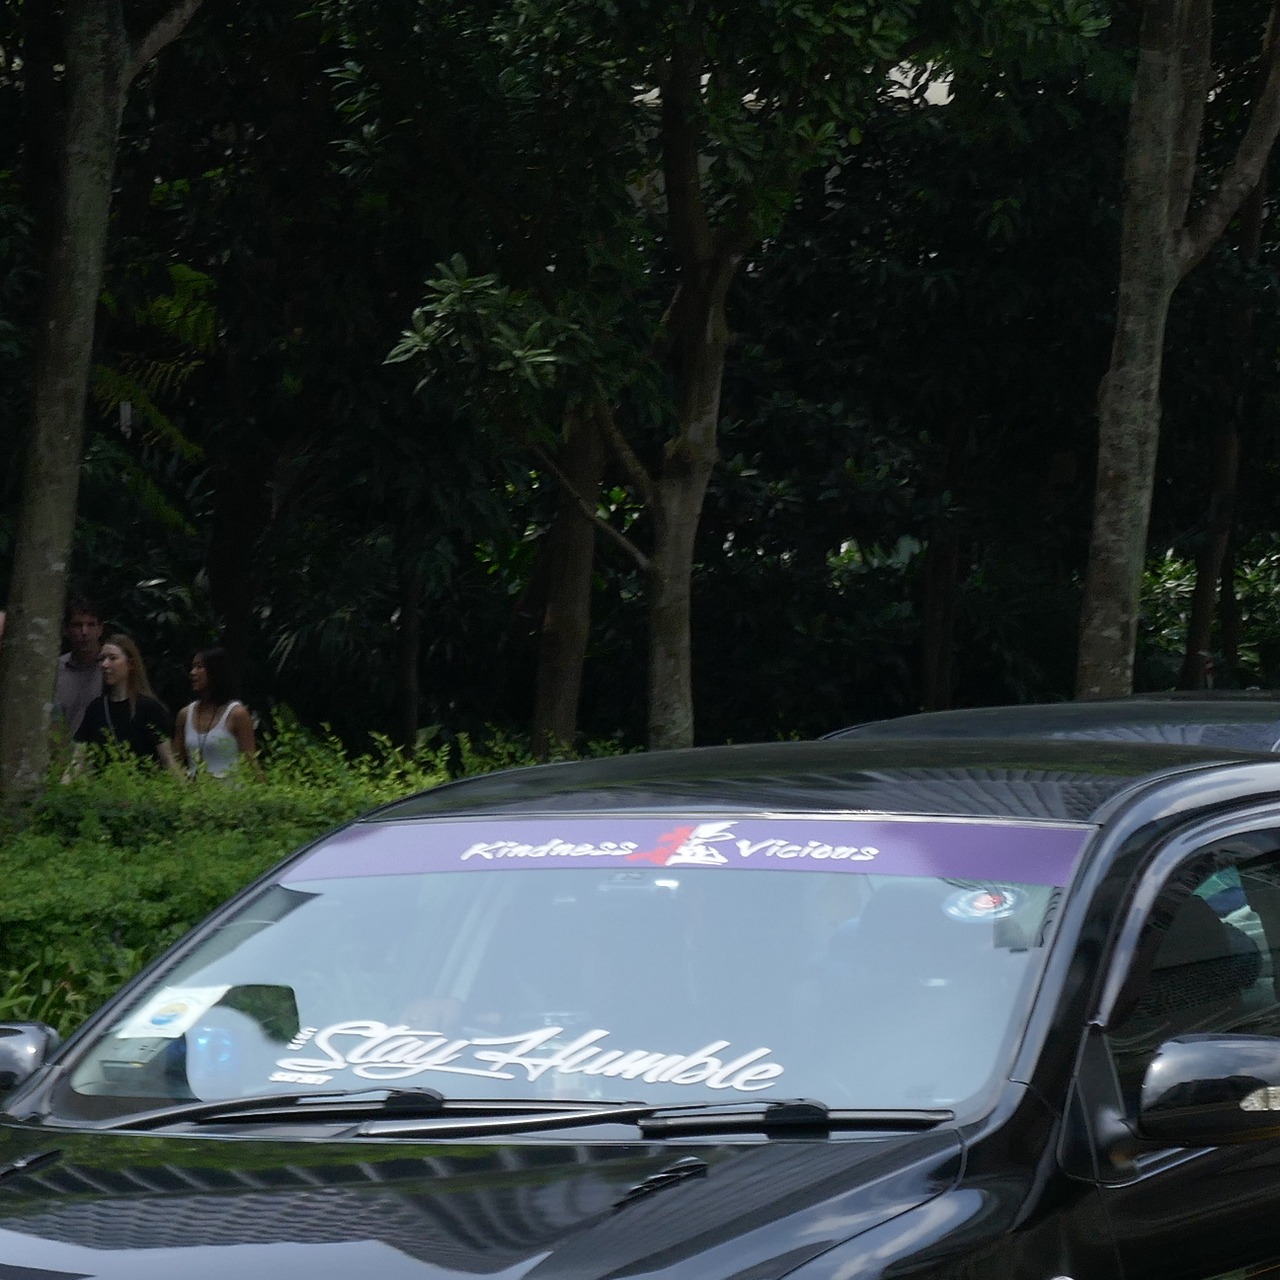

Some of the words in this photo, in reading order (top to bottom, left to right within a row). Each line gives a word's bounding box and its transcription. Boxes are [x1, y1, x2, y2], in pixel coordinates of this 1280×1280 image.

[460, 838, 639, 861] Kindness
[735, 838, 881, 862] Vicious
[275, 1019, 515, 1080] Stay
[470, 1026, 785, 1092] Humble
